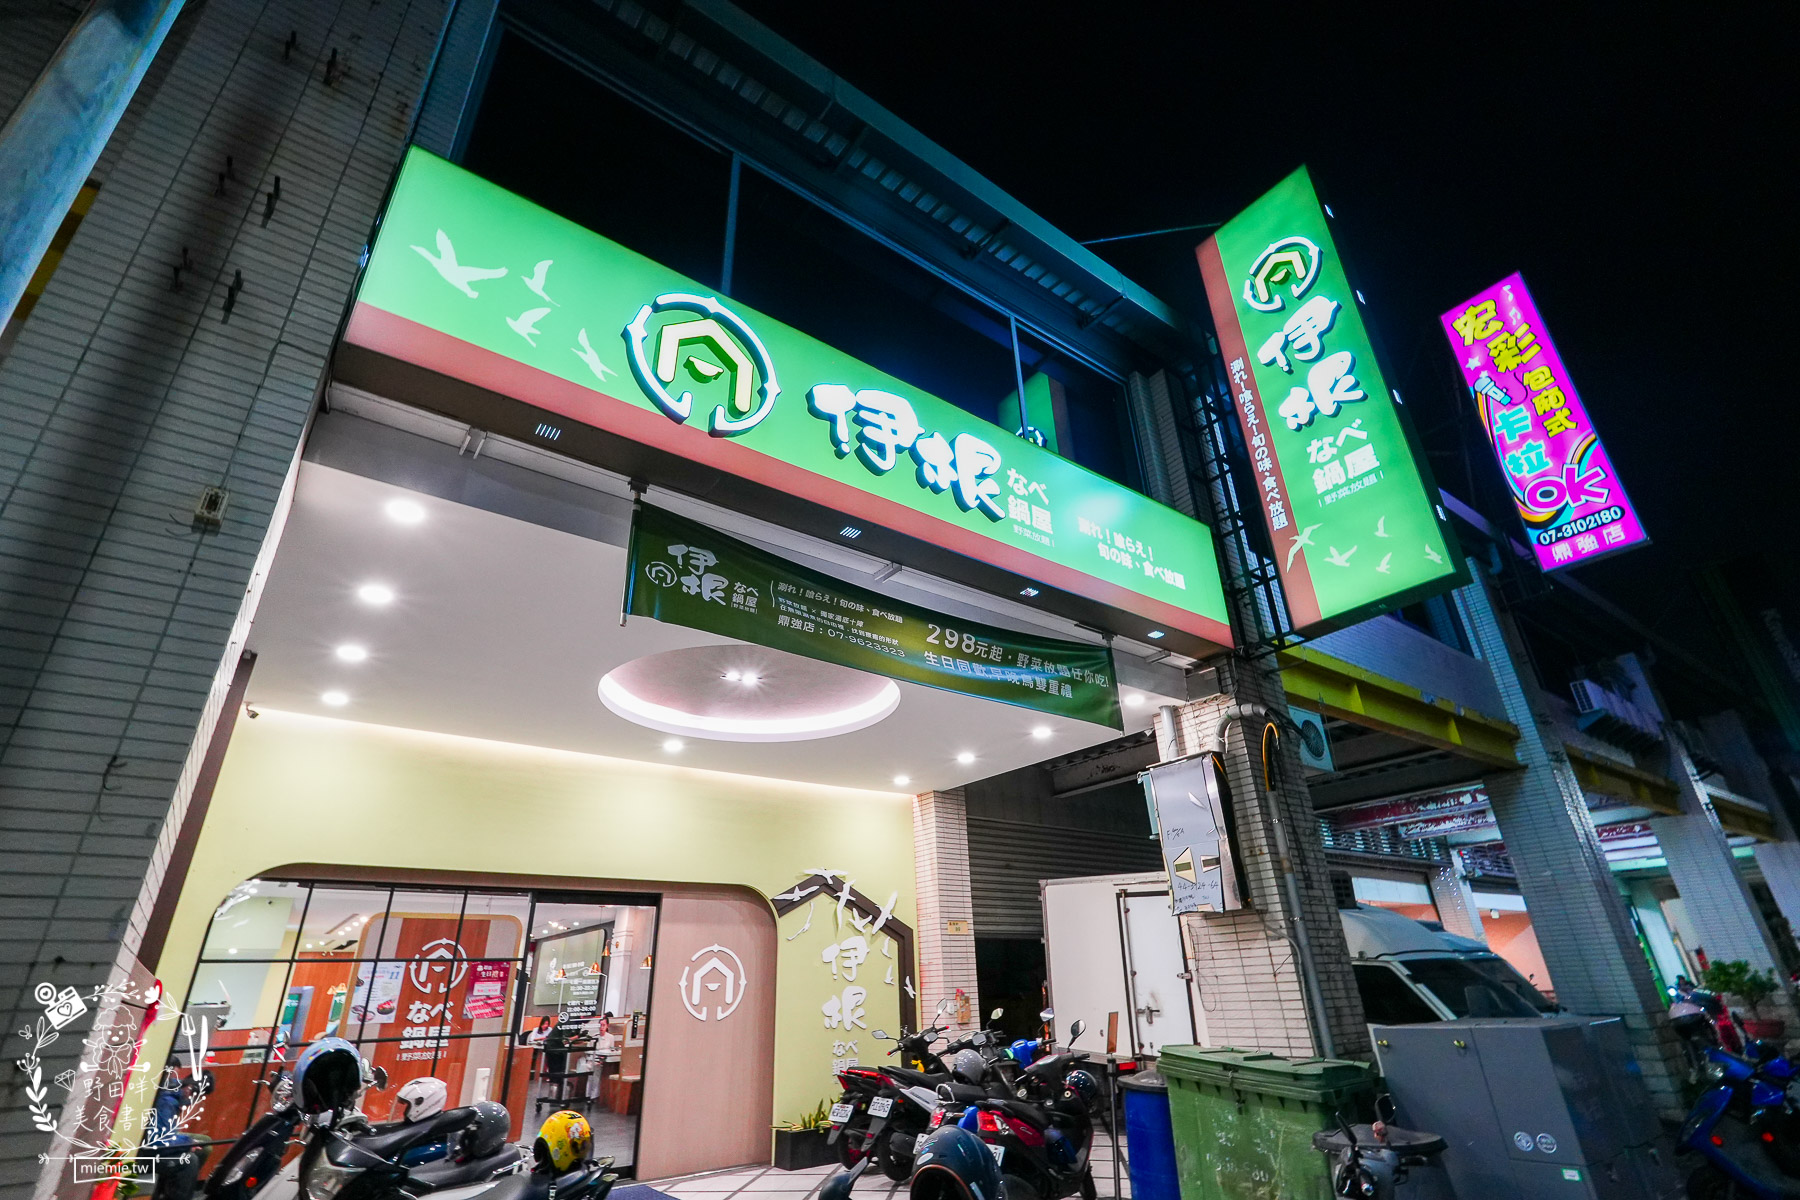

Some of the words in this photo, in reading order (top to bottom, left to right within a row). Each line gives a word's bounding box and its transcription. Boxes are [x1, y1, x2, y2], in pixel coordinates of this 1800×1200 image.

[1306, 418, 1368, 464] なべ
[1495, 404, 1553, 478] 卡拉
[1006, 467, 1050, 506] なべ
[1312, 442, 1381, 496] 鍋屋
[1523, 463, 1611, 513] OK
[1007, 494, 1054, 535] 鍋屋
[1539, 505, 1623, 545] 07-3102180
[731, 592, 758, 608] 鍋屋
[733, 581, 759, 597] なべ
[406, 1000, 455, 1025] なべ
[832, 1039, 859, 1057] なべ
